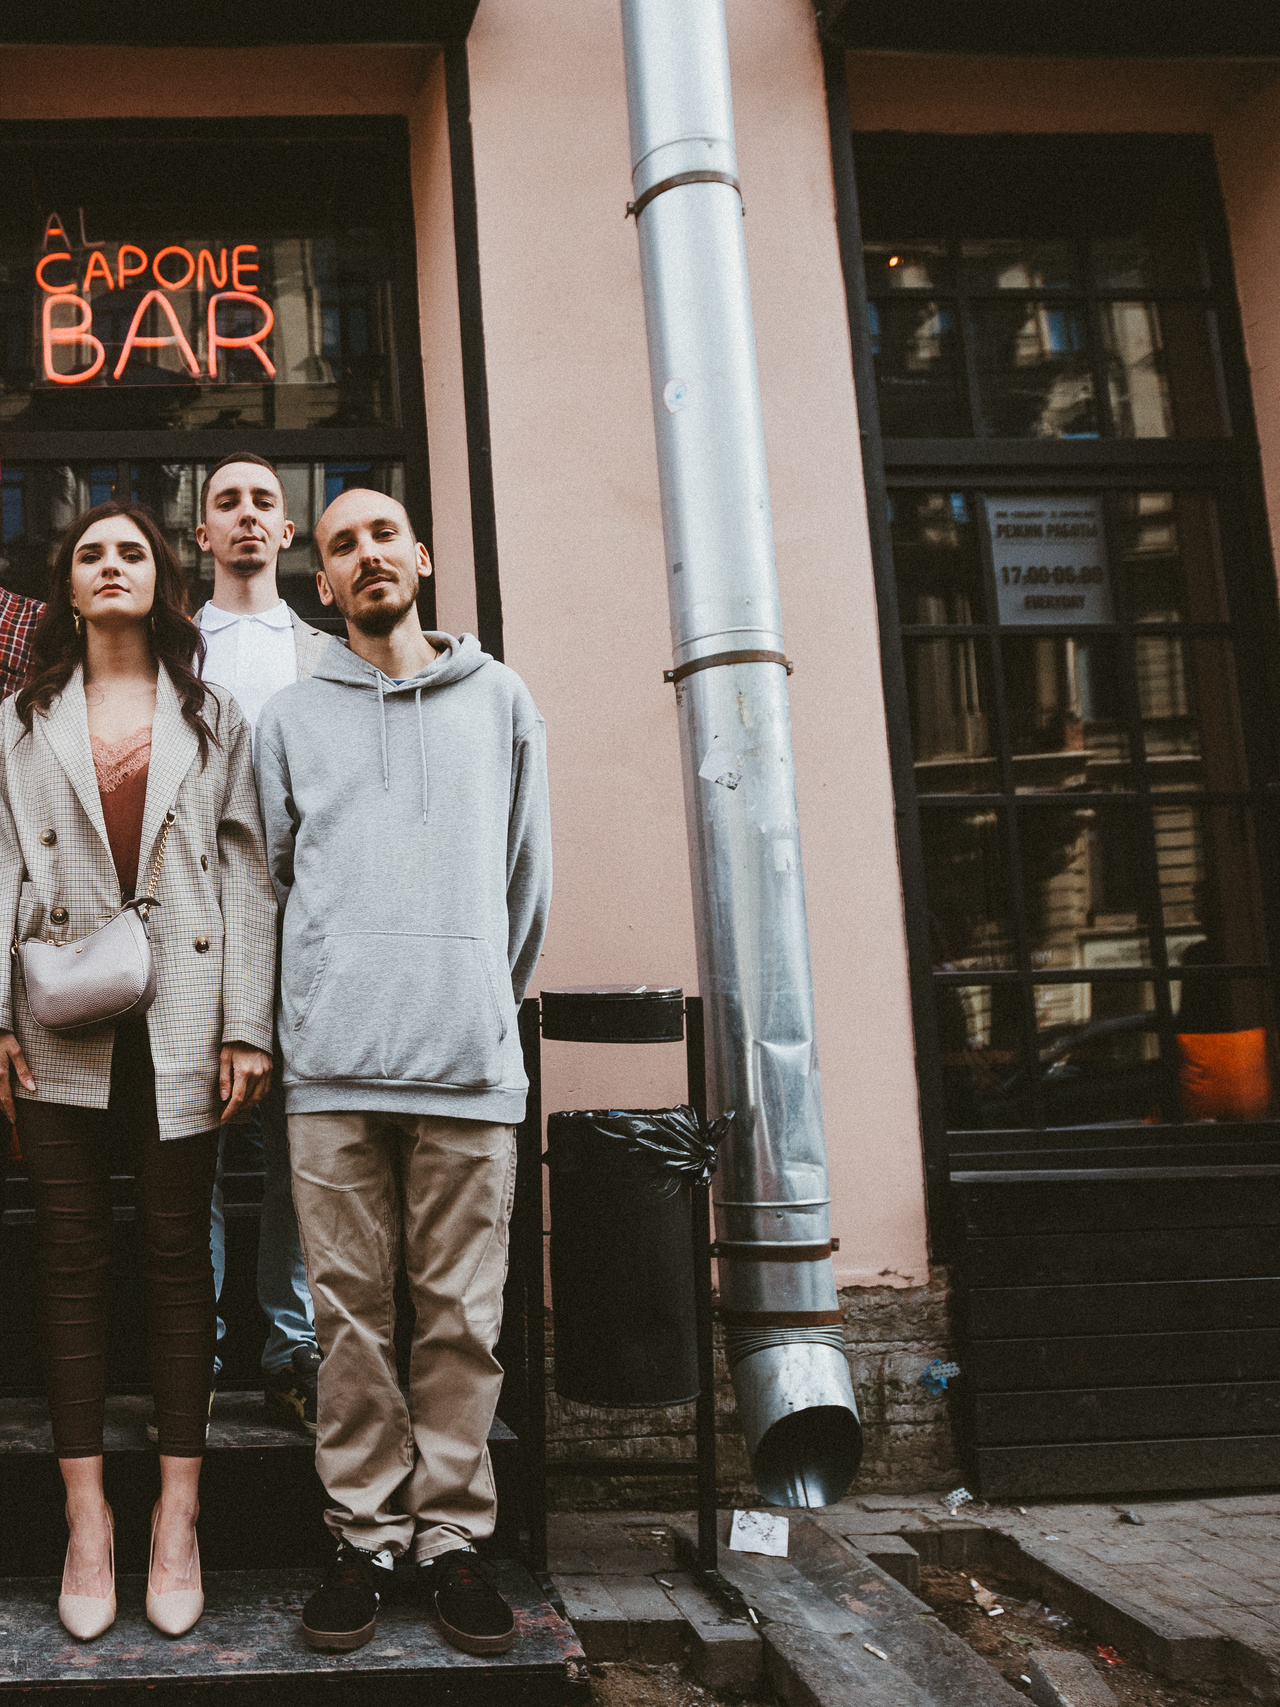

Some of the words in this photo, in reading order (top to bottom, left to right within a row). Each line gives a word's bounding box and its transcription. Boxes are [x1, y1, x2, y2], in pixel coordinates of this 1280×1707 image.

[41, 207, 105, 250] AL
[35, 244, 259, 294] CAPONE
[42, 289, 277, 384] BAR
